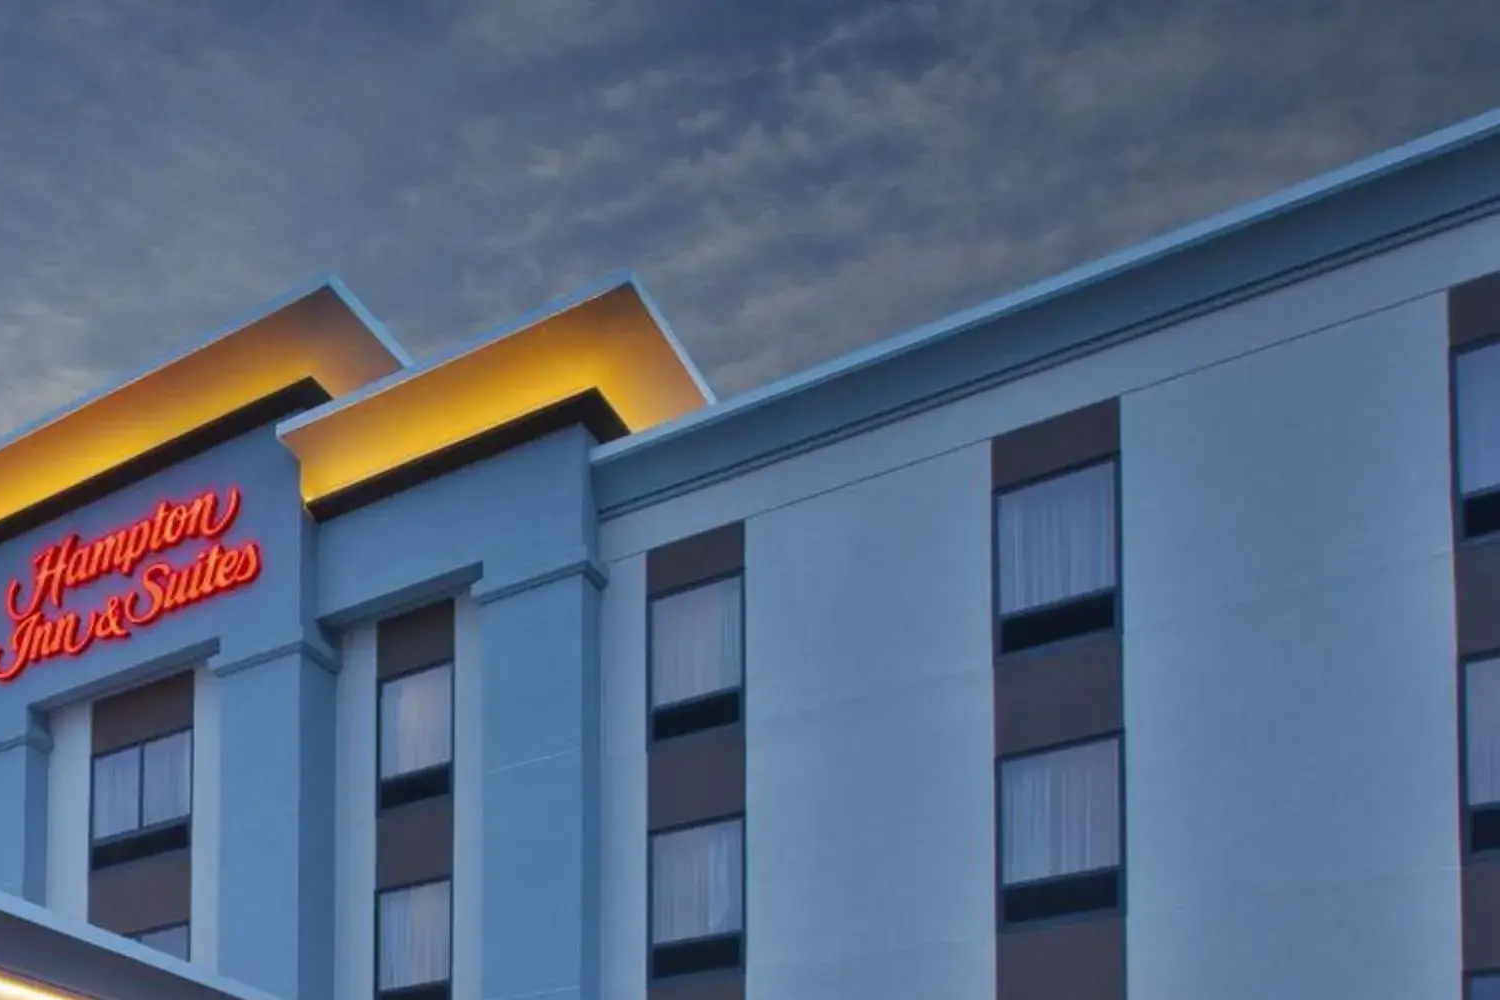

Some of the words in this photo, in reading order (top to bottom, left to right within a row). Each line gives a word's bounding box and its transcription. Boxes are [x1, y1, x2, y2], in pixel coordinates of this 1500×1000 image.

[6, 486, 241, 622] Hampton
[94, 595, 131, 640] &
[123, 542, 261, 626] Suites
